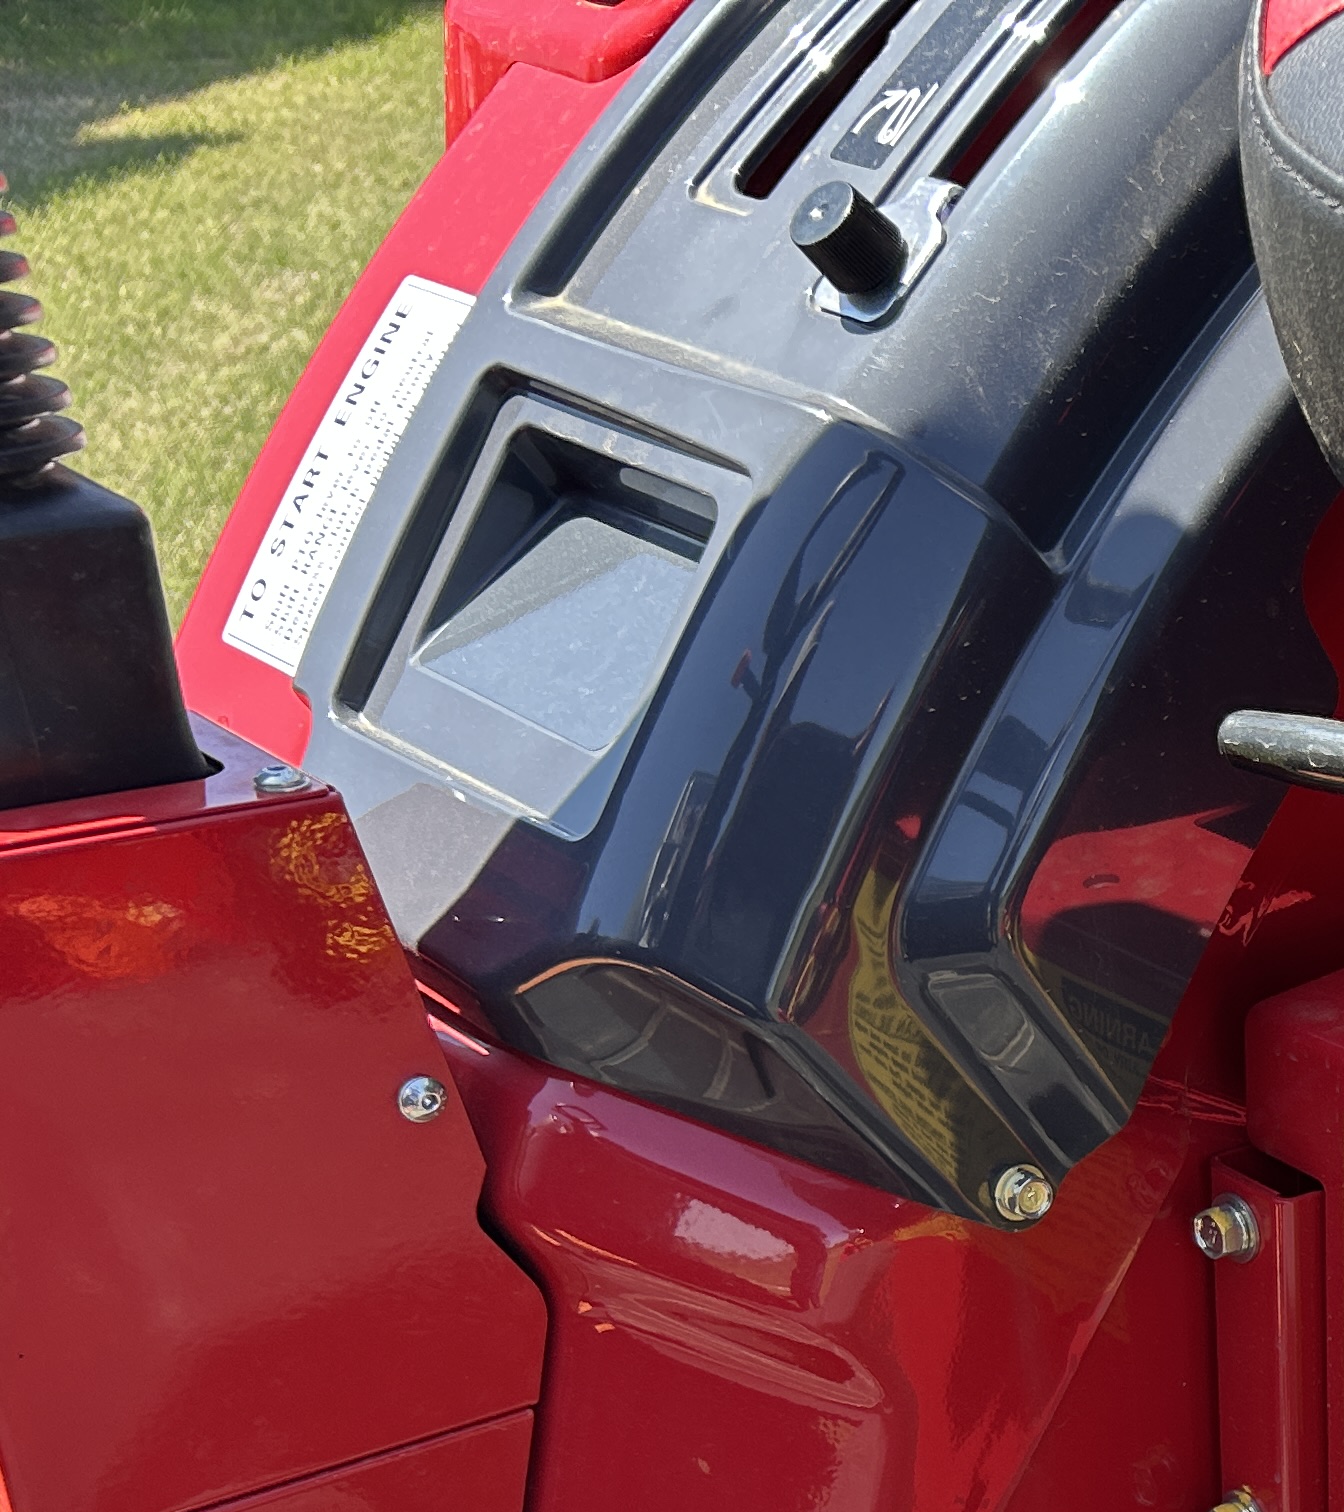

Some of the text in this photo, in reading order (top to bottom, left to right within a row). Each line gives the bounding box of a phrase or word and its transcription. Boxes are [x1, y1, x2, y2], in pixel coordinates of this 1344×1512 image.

[239, 302, 413, 622] TO START ENGINE
